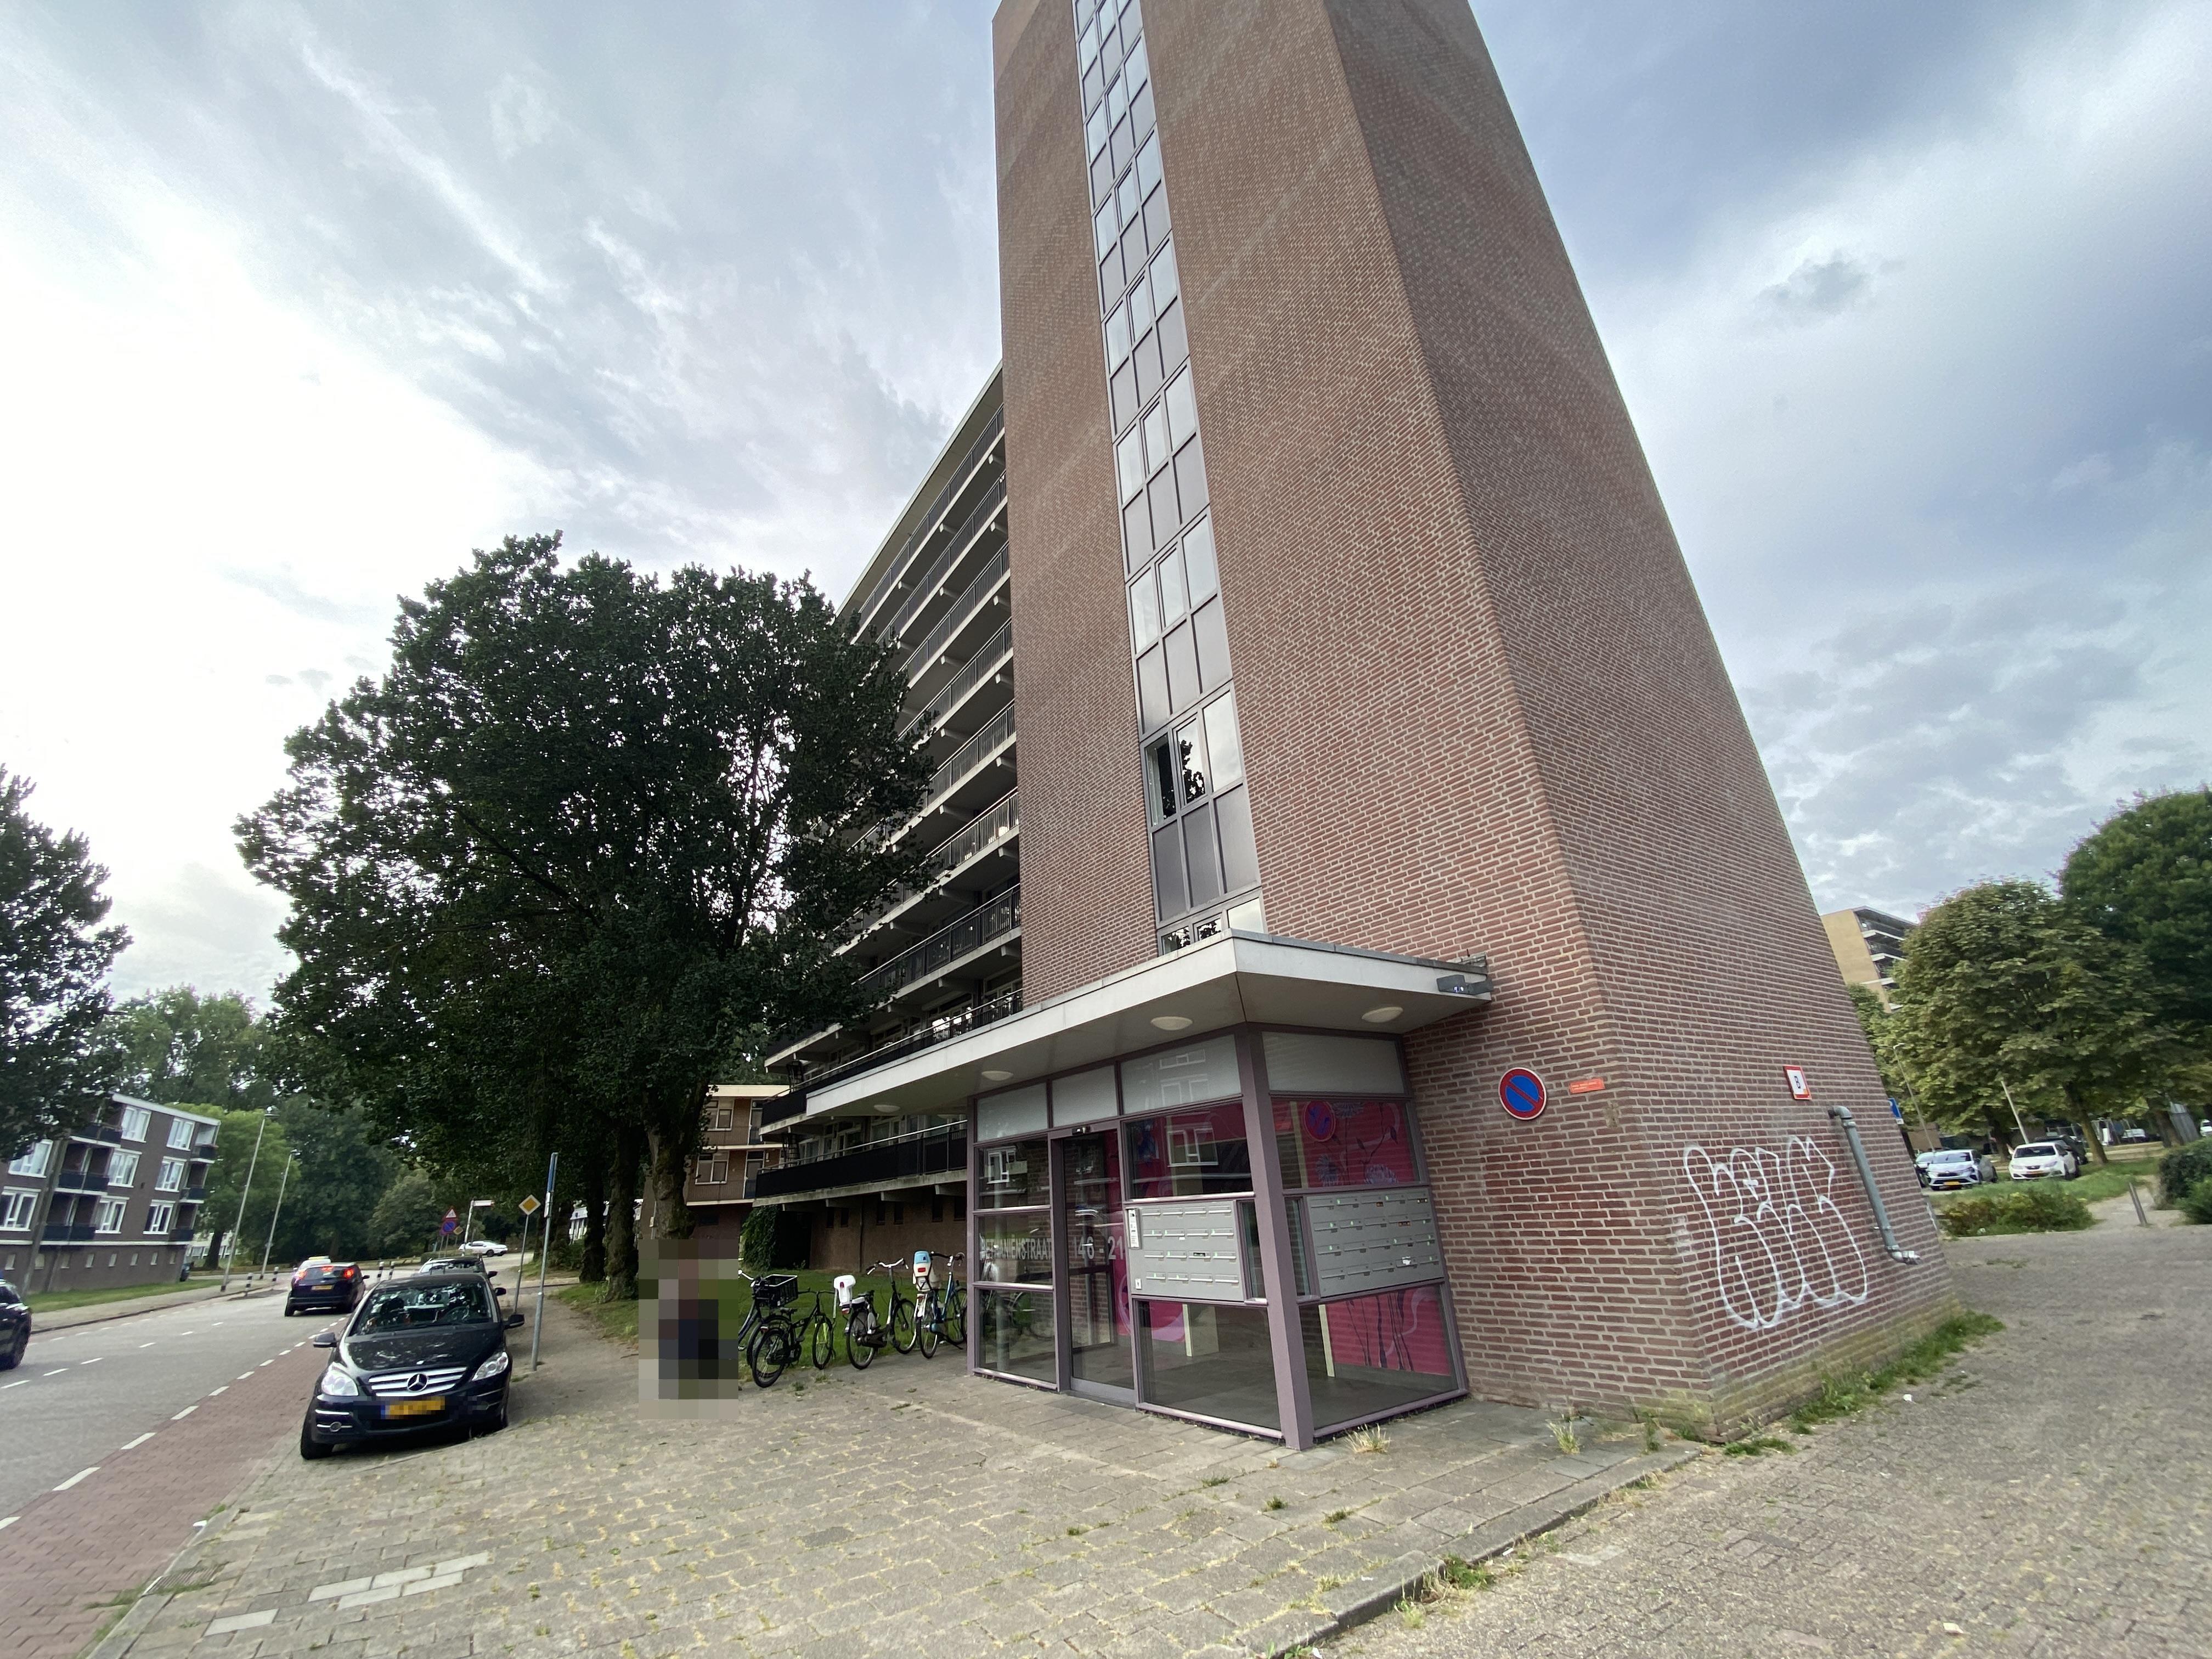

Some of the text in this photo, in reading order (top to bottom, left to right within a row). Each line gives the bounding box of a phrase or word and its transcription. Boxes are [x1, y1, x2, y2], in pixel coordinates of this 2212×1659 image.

[1794, 1076, 1801, 1089] B
[980, 1234, 1052, 1260] ETANIËNSTRAAT
[1074, 1236, 1094, 1260] 146
